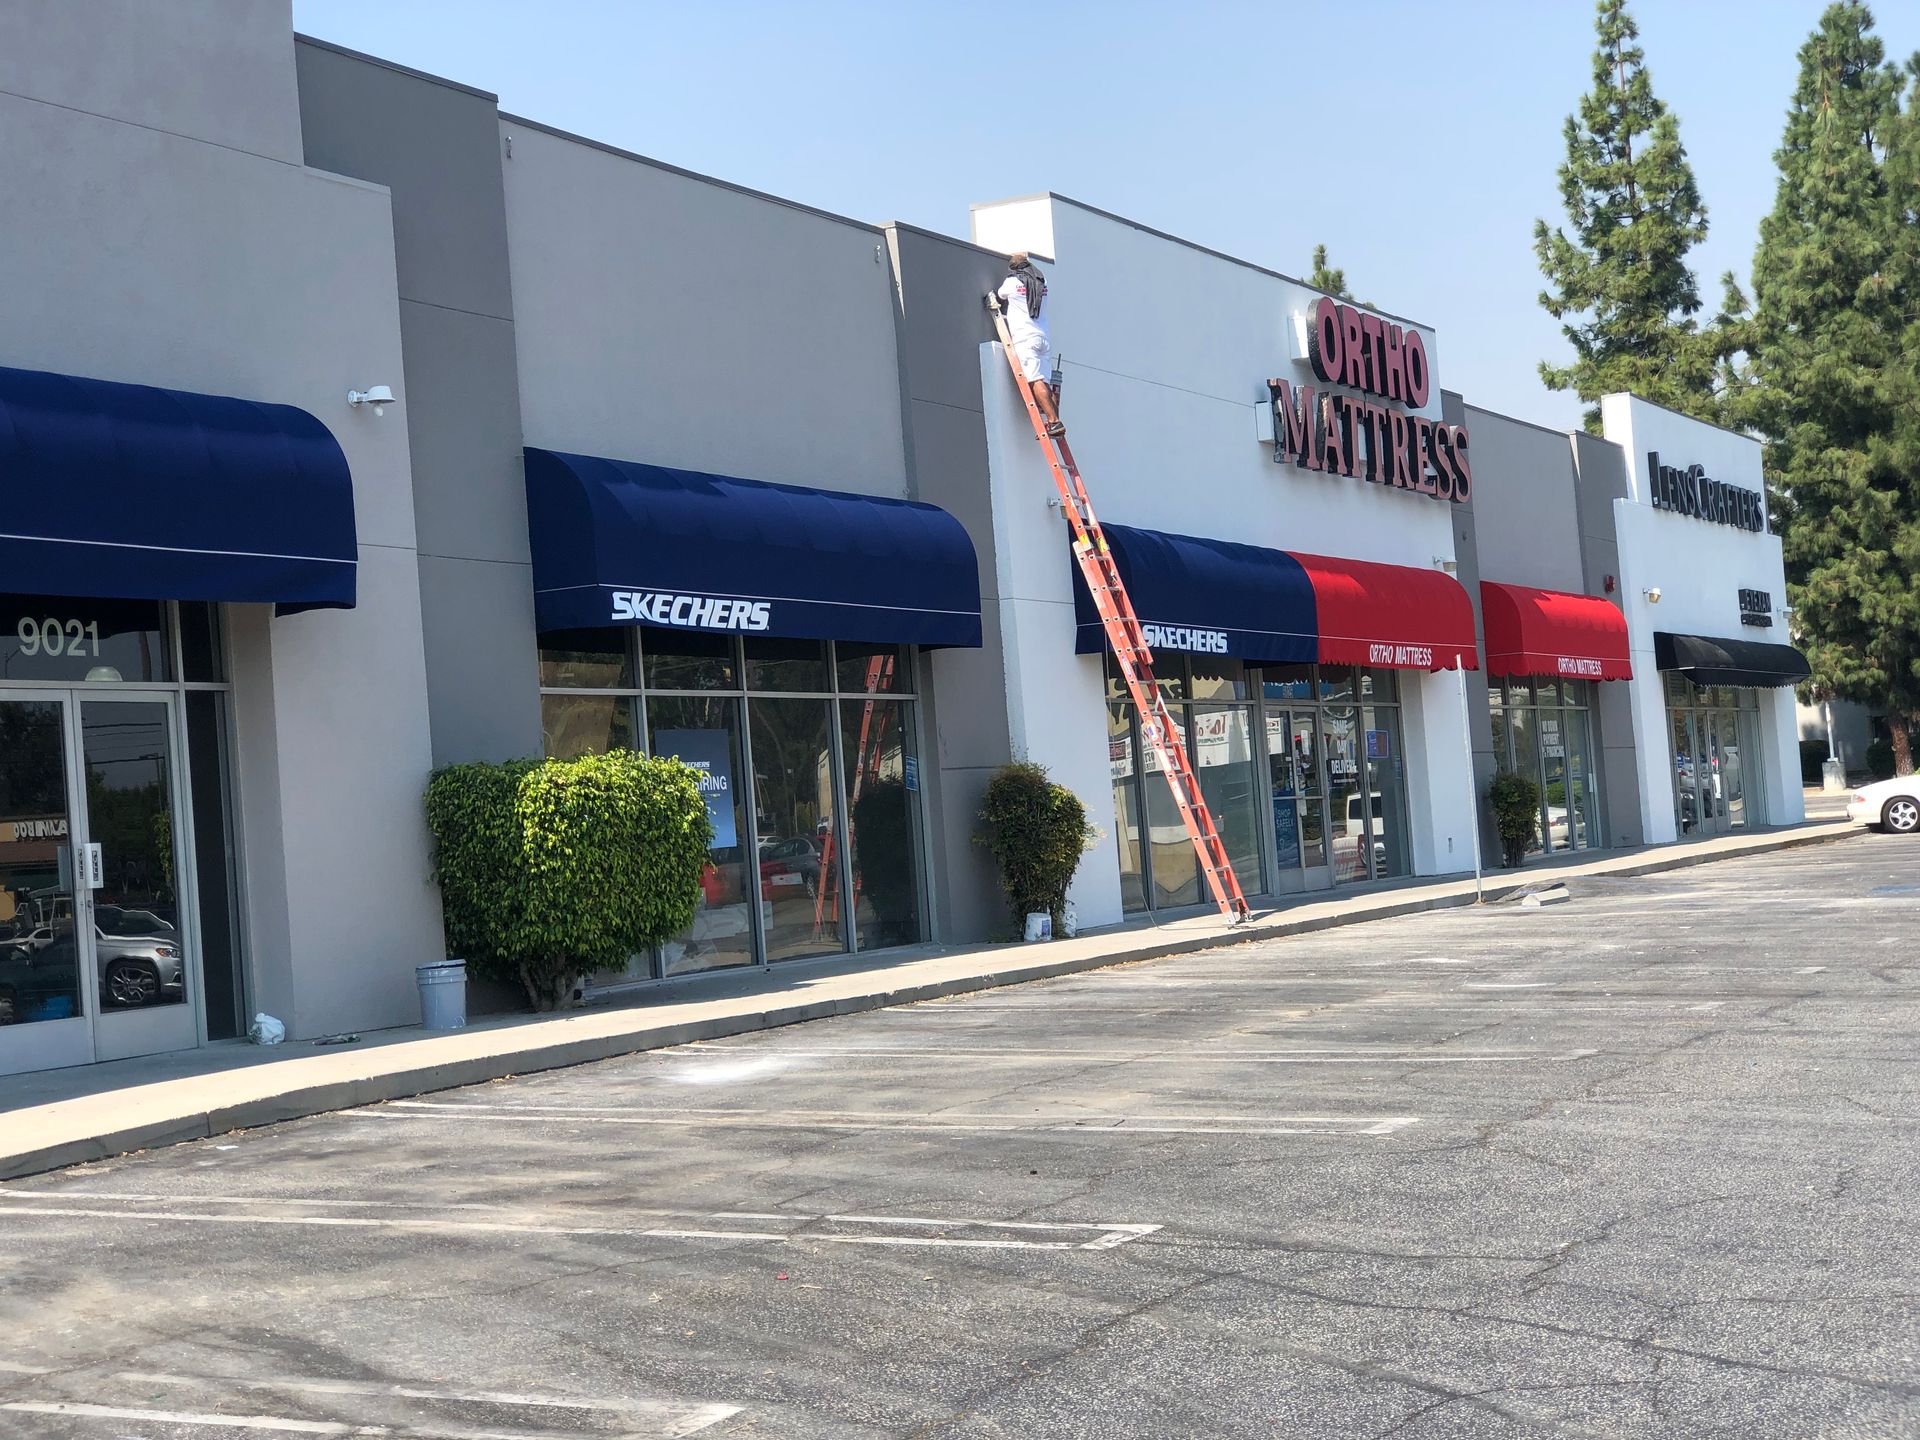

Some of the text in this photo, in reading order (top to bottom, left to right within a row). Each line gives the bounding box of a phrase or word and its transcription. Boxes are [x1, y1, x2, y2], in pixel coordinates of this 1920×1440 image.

[1307, 296, 1429, 409] ORTHO
[1267, 378, 1472, 503] MATTRESS
[611, 591, 771, 631] SKECHERS
[18, 617, 100, 656] 9021
[1142, 624, 1228, 653] SKECHERS
[1369, 644, 1432, 666] ORTHO MATTRESS
[1558, 657, 1577, 674] ORTHO
